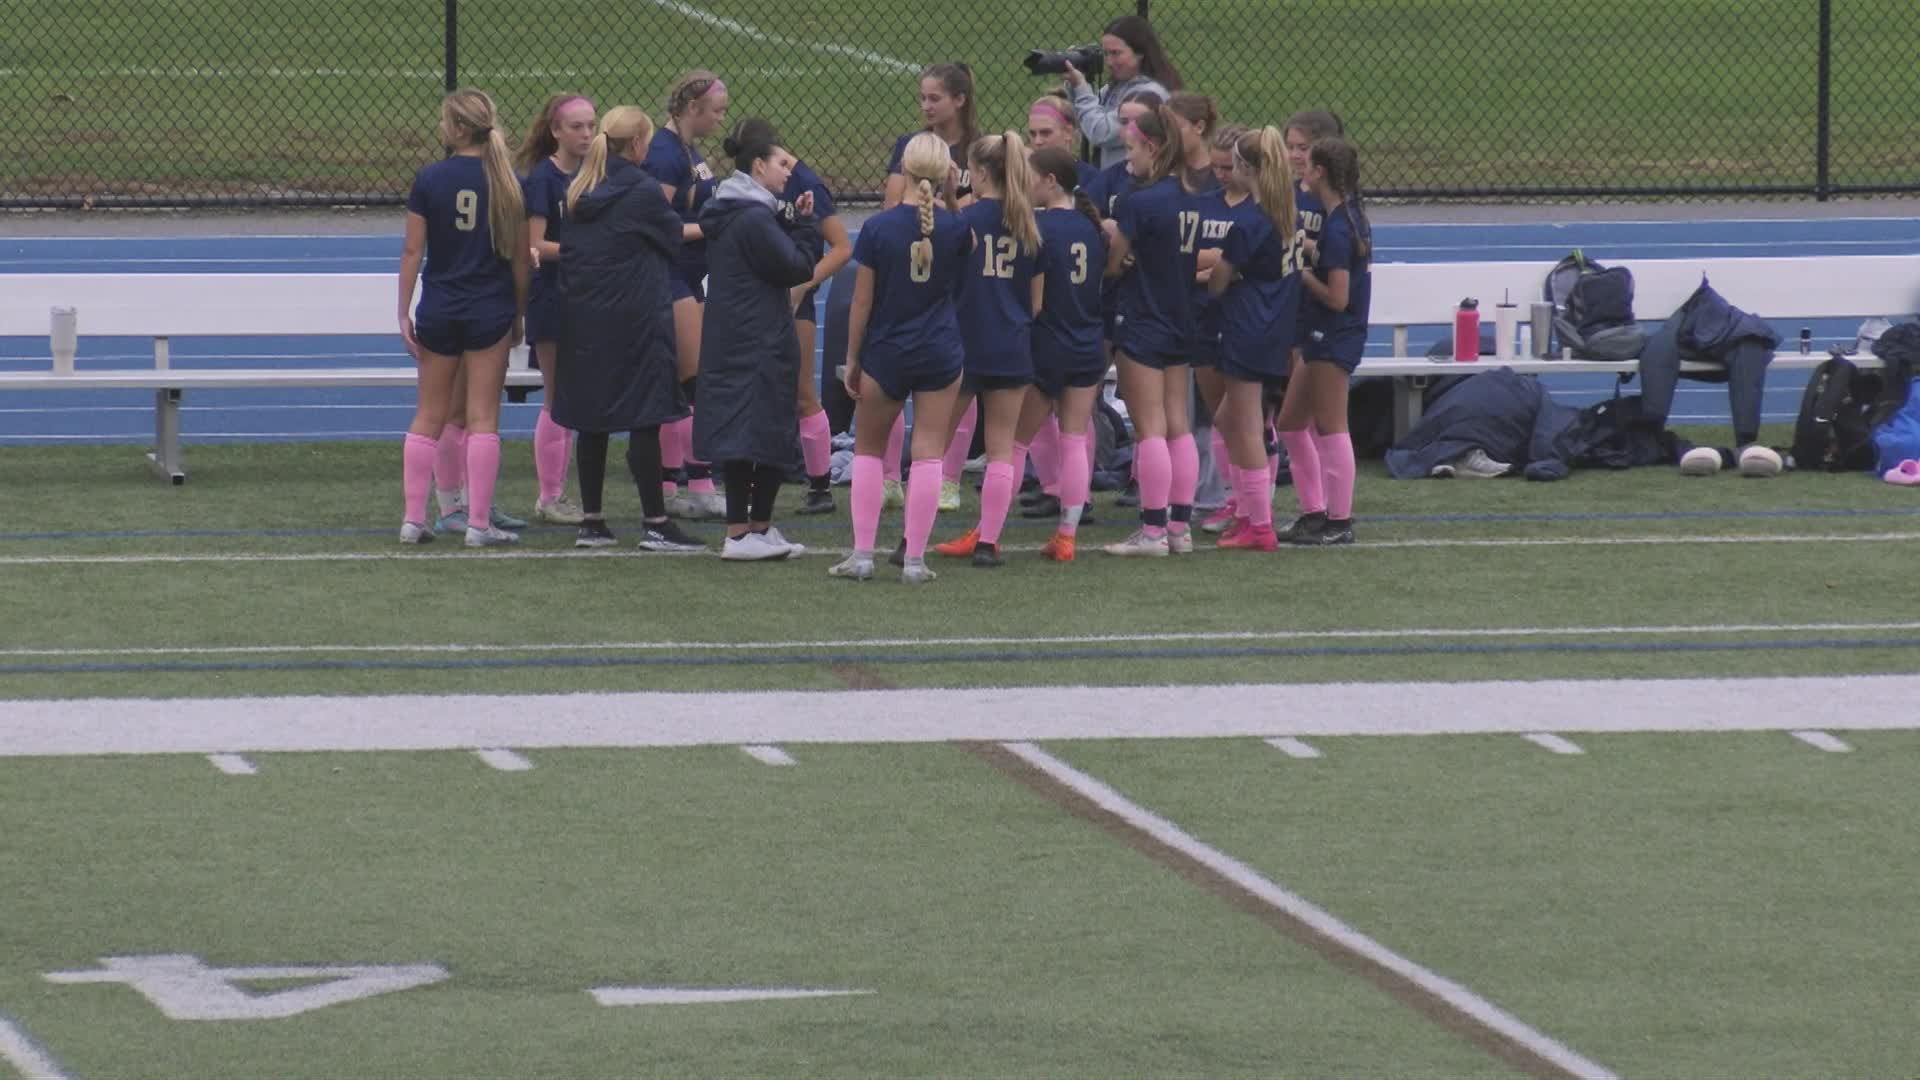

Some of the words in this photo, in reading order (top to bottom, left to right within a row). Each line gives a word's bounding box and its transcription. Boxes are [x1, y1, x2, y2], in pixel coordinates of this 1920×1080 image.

[456, 189, 477, 231] 9
[982, 233, 1018, 279] 12
[1070, 242, 1088, 285] 3
